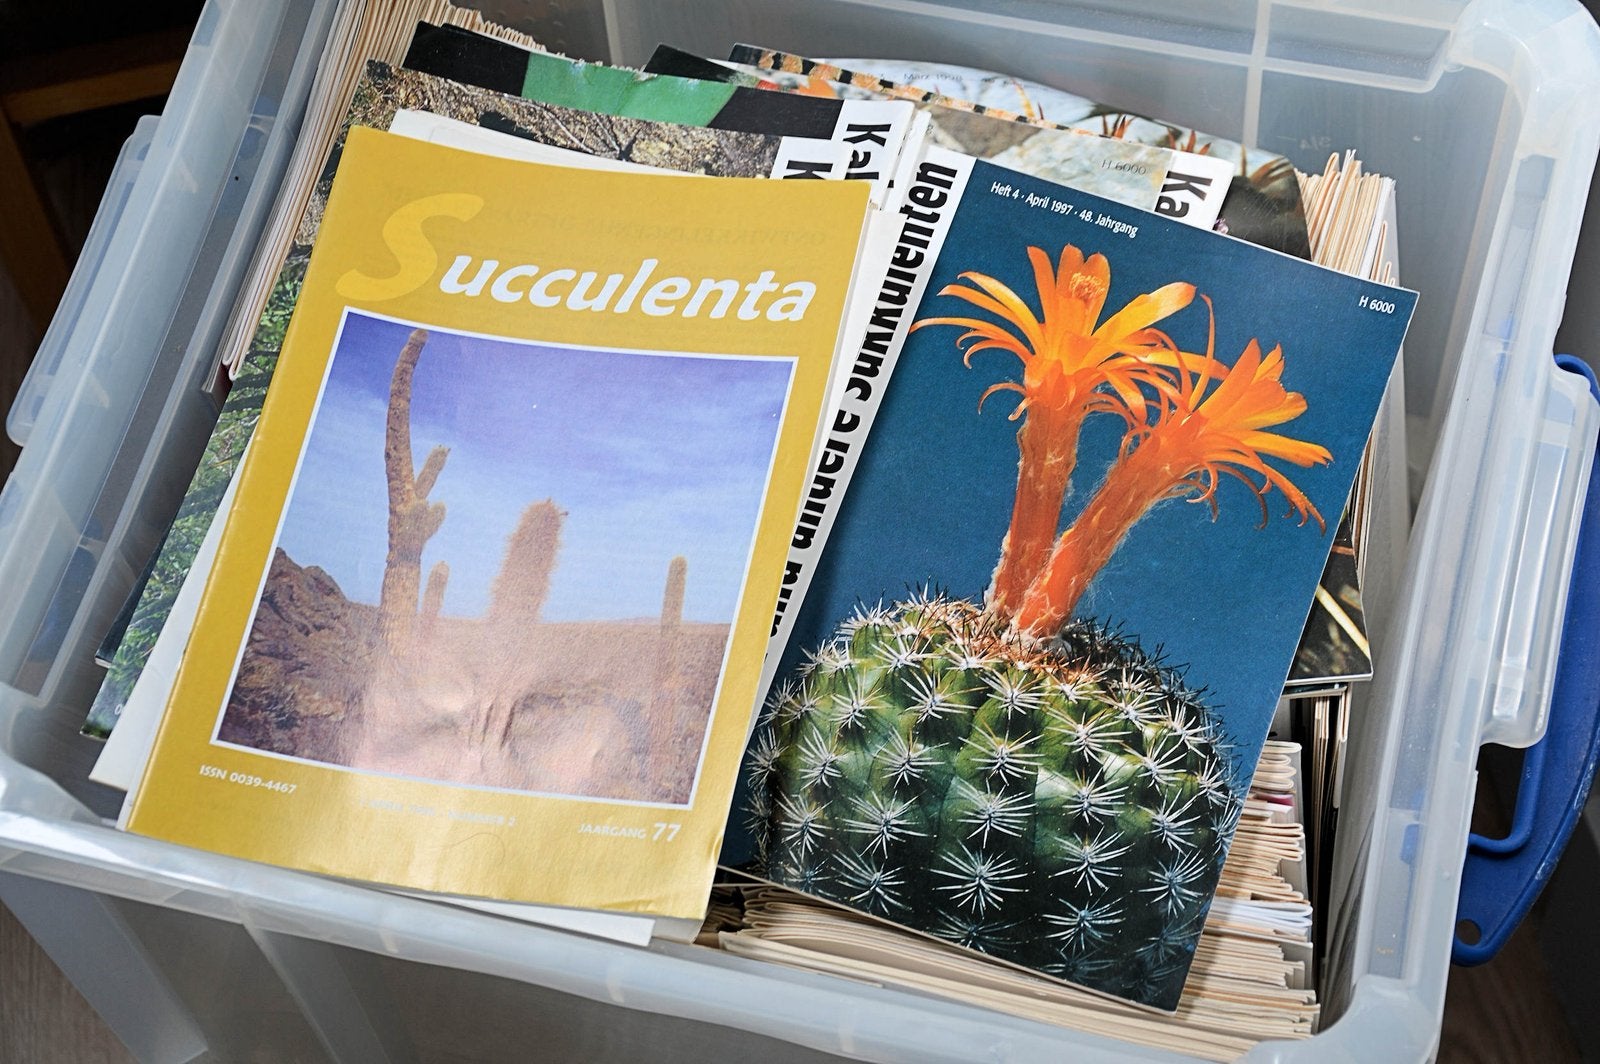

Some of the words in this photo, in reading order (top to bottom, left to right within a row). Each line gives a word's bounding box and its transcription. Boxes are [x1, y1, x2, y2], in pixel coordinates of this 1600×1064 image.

[990, 181, 1012, 198] Heft
[1011, 188, 1020, 200] 4
[1025, 192, 1050, 208] April
[1050, 200, 1074, 216] 1997
[1094, 213, 1139, 239] Jahrgang
[335, 192, 818, 323] Succulenta
[1358, 295, 1369, 308] H
[1369, 299, 1396, 314] 6000
[199, 764, 228, 780] ISSN
[229, 771, 298, 795] 0039-4467
[577, 823, 647, 840] JAARGANG
[652, 821, 682, 842] 77
